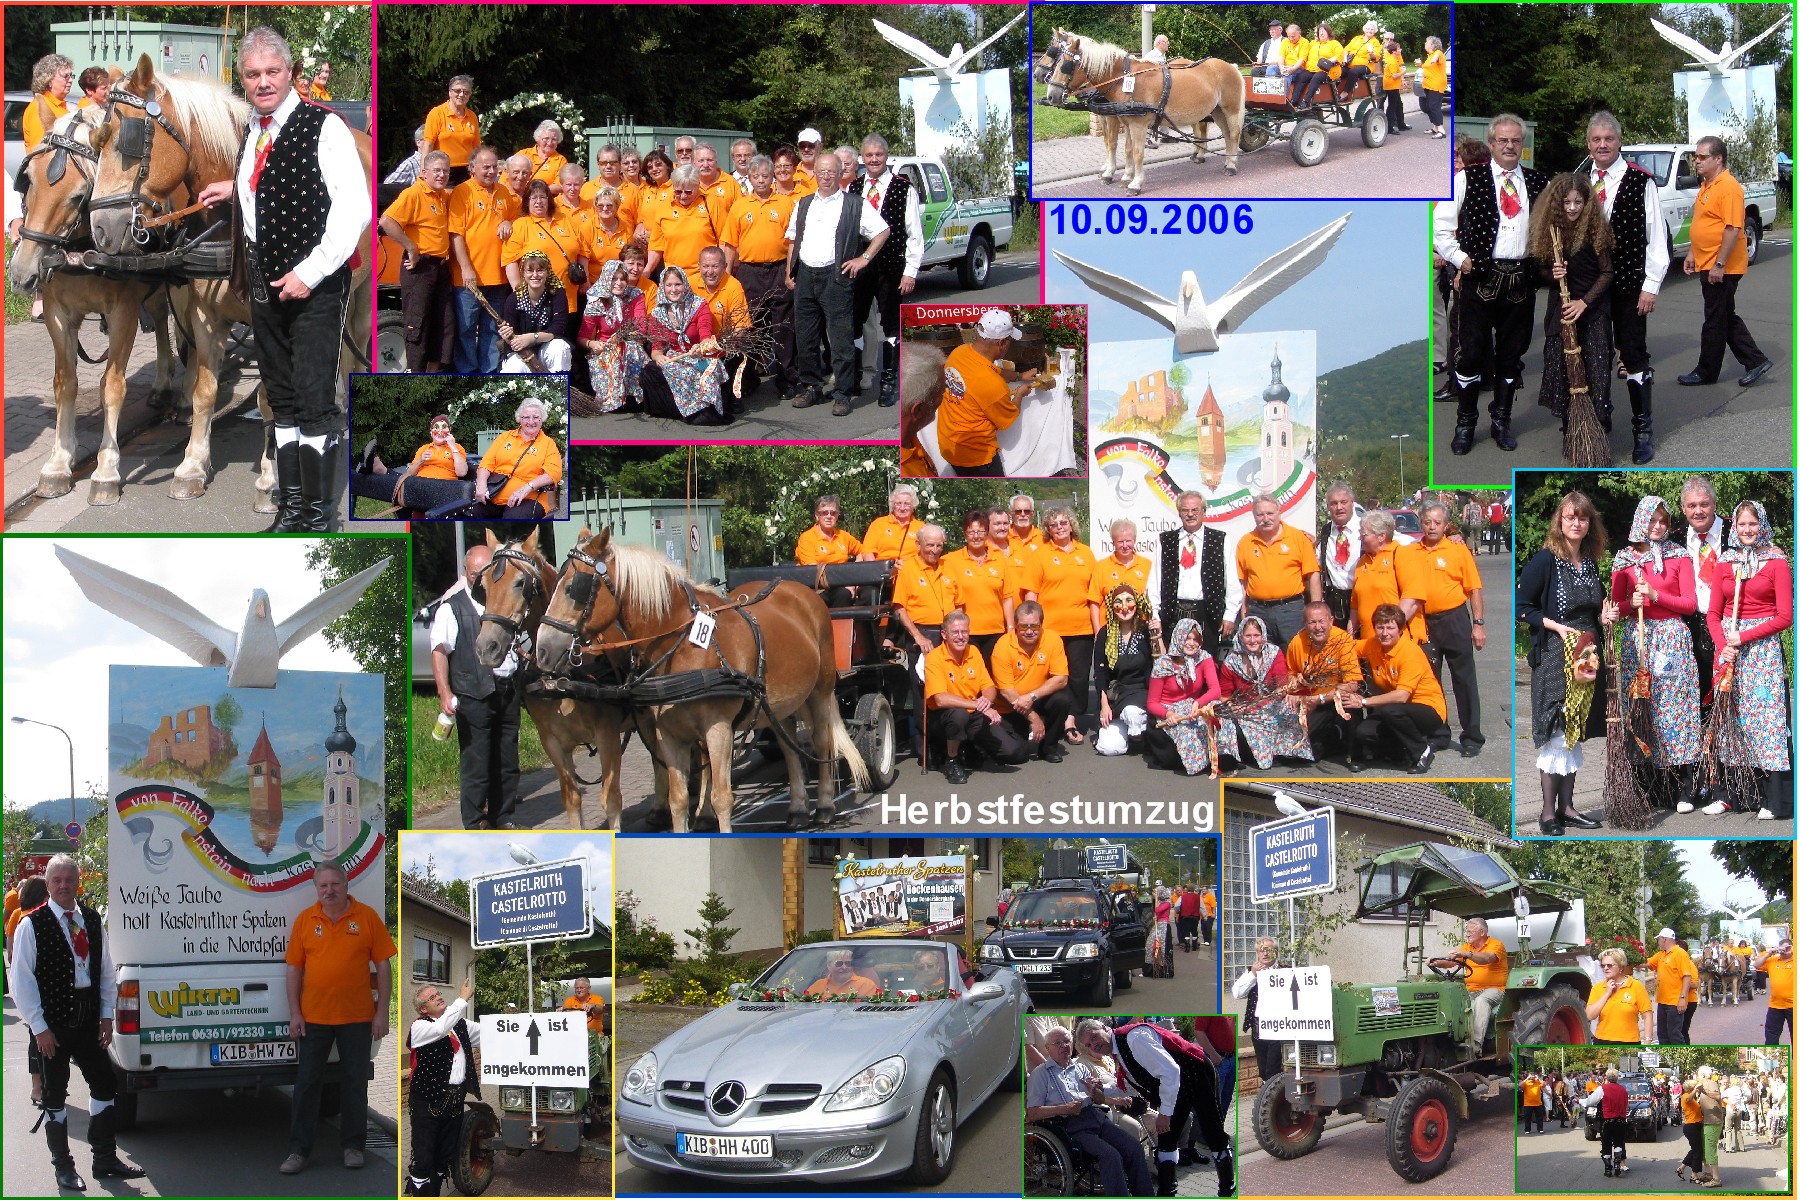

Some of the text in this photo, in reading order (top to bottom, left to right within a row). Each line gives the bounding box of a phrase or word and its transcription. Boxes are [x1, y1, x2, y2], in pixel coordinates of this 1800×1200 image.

[1106, 444, 1127, 457] von
[1153, 475, 1179, 502] nste
[696, 622, 709, 643] 18
[131, 792, 159, 808] von
[1266, 823, 1315, 850] KASTELRUTH
[1265, 843, 1318, 868] CASTELROTTO
[842, 860, 964, 880] Kastelruther Spatzen
[242, 871, 276, 888] nach
[493, 872, 563, 897] KASTELRUTH
[120, 883, 222, 909] Weiße Taube
[491, 890, 567, 915] CASTELROTTO
[123, 910, 288, 934] holt Kastelruther Spatzen
[1520, 924, 1529, 936] 17
[183, 937, 195, 954] in
[200, 937, 220, 954] die
[1269, 972, 1318, 988] Sie ist
[221, 1007, 269, 1015] GARTENTECHNIK
[496, 1017, 569, 1033] Sie ist
[1260, 1017, 1331, 1032] angekommen
[149, 1030, 190, 1042] Telefon
[192, 1025, 265, 1040] 06361/92330
[220, 1046, 247, 1060] KIB
[256, 1044, 274, 1059] HW
[277, 1043, 295, 1057] 76
[483, 1061, 587, 1078] angekommen
[685, 1135, 708, 1154] KIB
[718, 1138, 738, 1155] HH
[742, 1138, 769, 1155] 400
